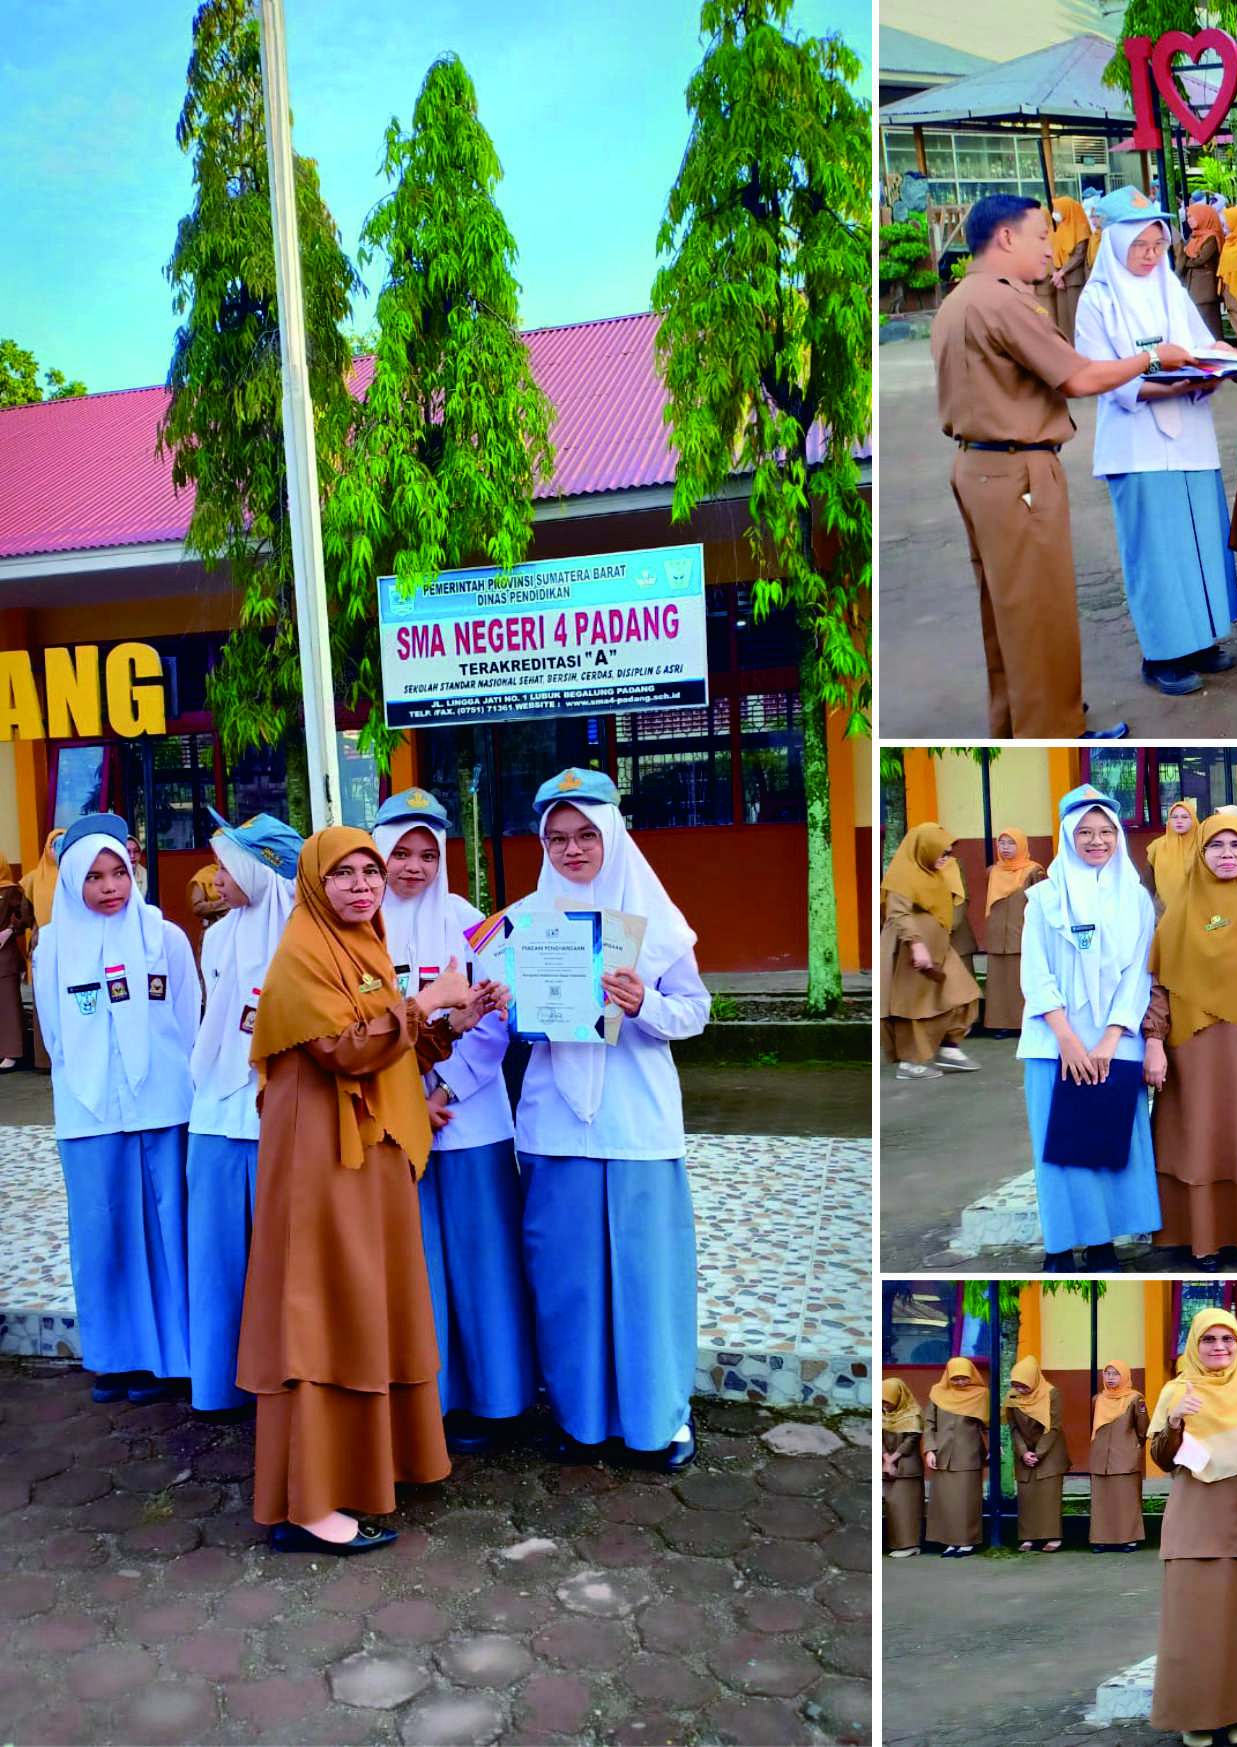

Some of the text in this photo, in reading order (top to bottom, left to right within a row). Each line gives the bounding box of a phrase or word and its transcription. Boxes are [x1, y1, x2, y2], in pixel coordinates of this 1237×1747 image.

[423, 565, 626, 596] PEMERINTAH PROVINSI SUMATERA BARAT
[477, 586, 570, 606] DINAS PENDIDIKAN
[397, 604, 679, 661] SMA NEGERI 4 PADANG
[459, 655, 581, 676] TERAKREDITASI
[403, 683, 439, 694] SEKOLAH
[440, 680, 476, 691] STANDAR
[477, 676, 517, 688] NASIONAL
[617, 666, 654, 678] DISIPLIN
[663, 664, 683, 674] ASRI
[0, 642, 166, 742] ANG
[446, 697, 480, 706] LINGGA
[482, 696, 502, 704] JATI
[530, 692, 561, 700] LUBUK
[563, 688, 614, 698] BEGALUNG
[616, 685, 655, 694] PADANG
[515, 701, 555, 710] WEBSITE
